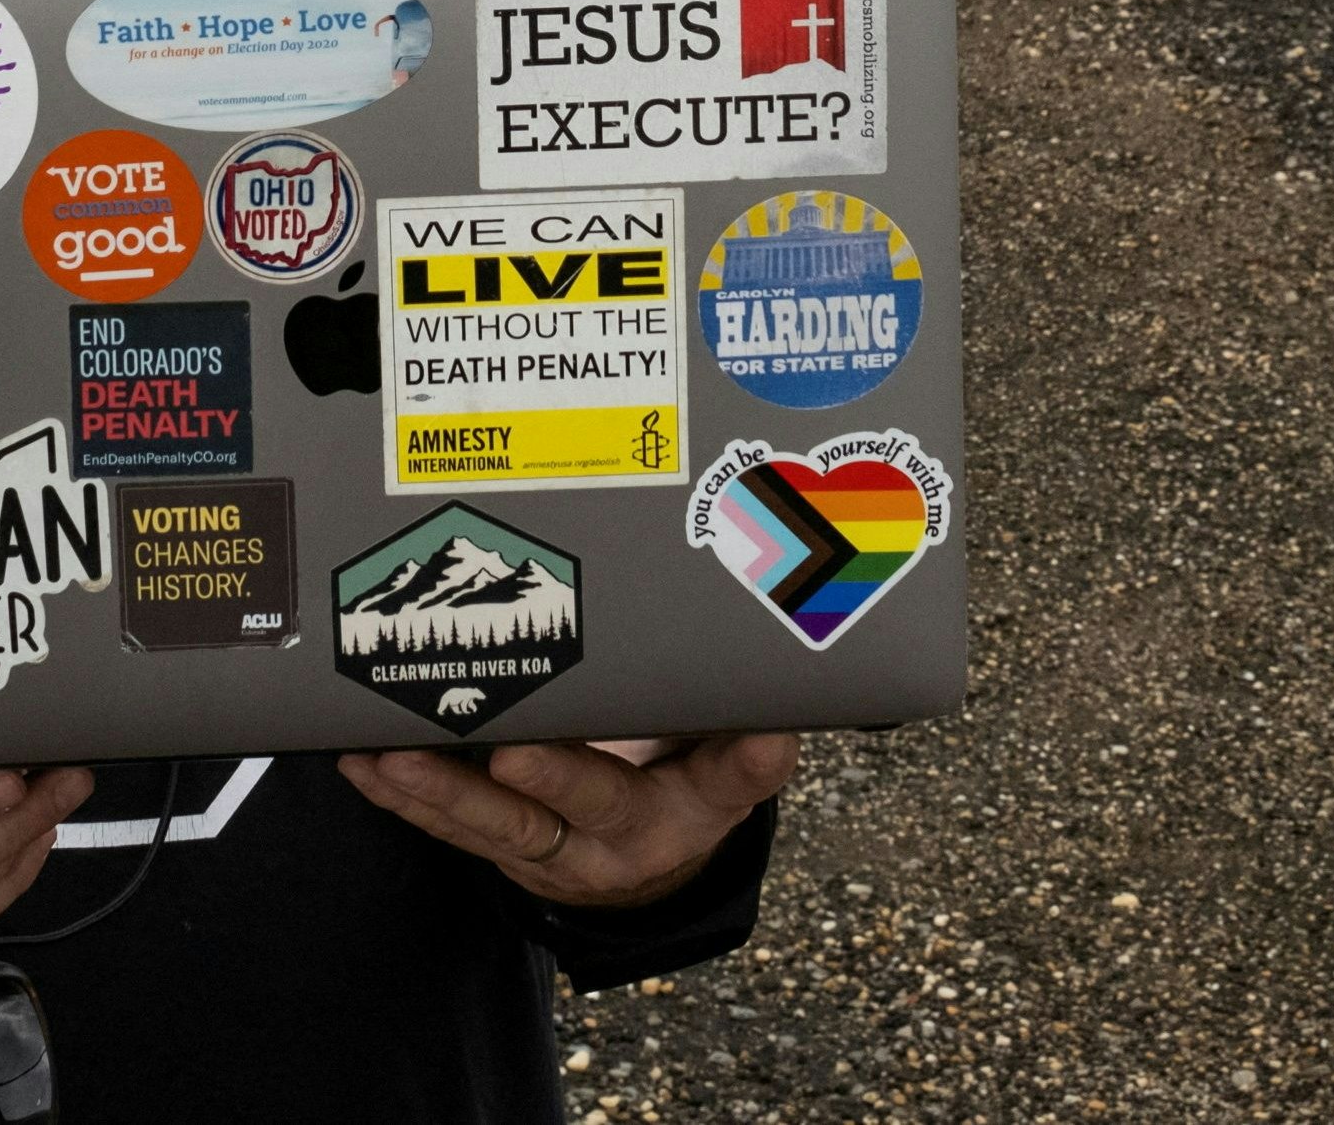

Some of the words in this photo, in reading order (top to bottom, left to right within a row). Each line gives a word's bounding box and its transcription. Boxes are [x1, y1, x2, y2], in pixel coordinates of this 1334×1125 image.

[98, 18, 175, 44] Faith
[198, 15, 275, 43] Hope
[298, 10, 367, 33] Love
[490, 0, 721, 85] JESUS
[129, 48, 149, 62] for
[161, 46, 205, 60] change
[208, 48, 223, 56] on
[227, 42, 277, 55] Election
[280, 41, 305, 55] Day
[307, 40, 339, 50] 2020
[496, 91, 851, 153] EXECUTE?
[46, 161, 166, 197] VOTE
[250, 178, 314, 207] OHIO
[54, 197, 172, 220] common
[235, 209, 307, 241] VOTED
[403, 218, 507, 248] WE
[531, 213, 663, 243] CAN
[53, 216, 186, 269] good
[402, 251, 665, 305] LIVE
[716, 288, 795, 300] CAROLYN
[79, 317, 125, 346] END
[406, 311, 582, 343] WITHOUT
[593, 308, 667, 336] THE
[715, 293, 899, 357] HARDING
[79, 346, 223, 378] COLORADO'S
[405, 355, 506, 386] DEATH
[517, 350, 666, 381] PENALTY!
[718, 359, 766, 375] FOR
[772, 355, 845, 373] STATE
[852, 353, 897, 369] REP
[80, 378, 198, 409] DEATH
[82, 409, 239, 440] PENALTY
[408, 426, 512, 454] AMNESTY
[83, 450, 237, 466] EndDeathPenaltyCO.org
[408, 455, 513, 474] INTERNATIONAL
[694, 498, 716, 539] you
[705, 462, 737, 496] can
[735, 448, 765, 469] be
[817, 437, 910, 474] yourself
[905, 455, 945, 501] with
[925, 504, 943, 538] me
[132, 505, 240, 534] VOTING
[135, 538, 264, 568] CHANGES
[137, 572, 251, 601] HISTORY.
[242, 613, 282, 629] ACLU
[372, 661, 467, 682] CLEARWATER
[472, 658, 517, 678] RIVER
[522, 657, 552, 674] KOA
